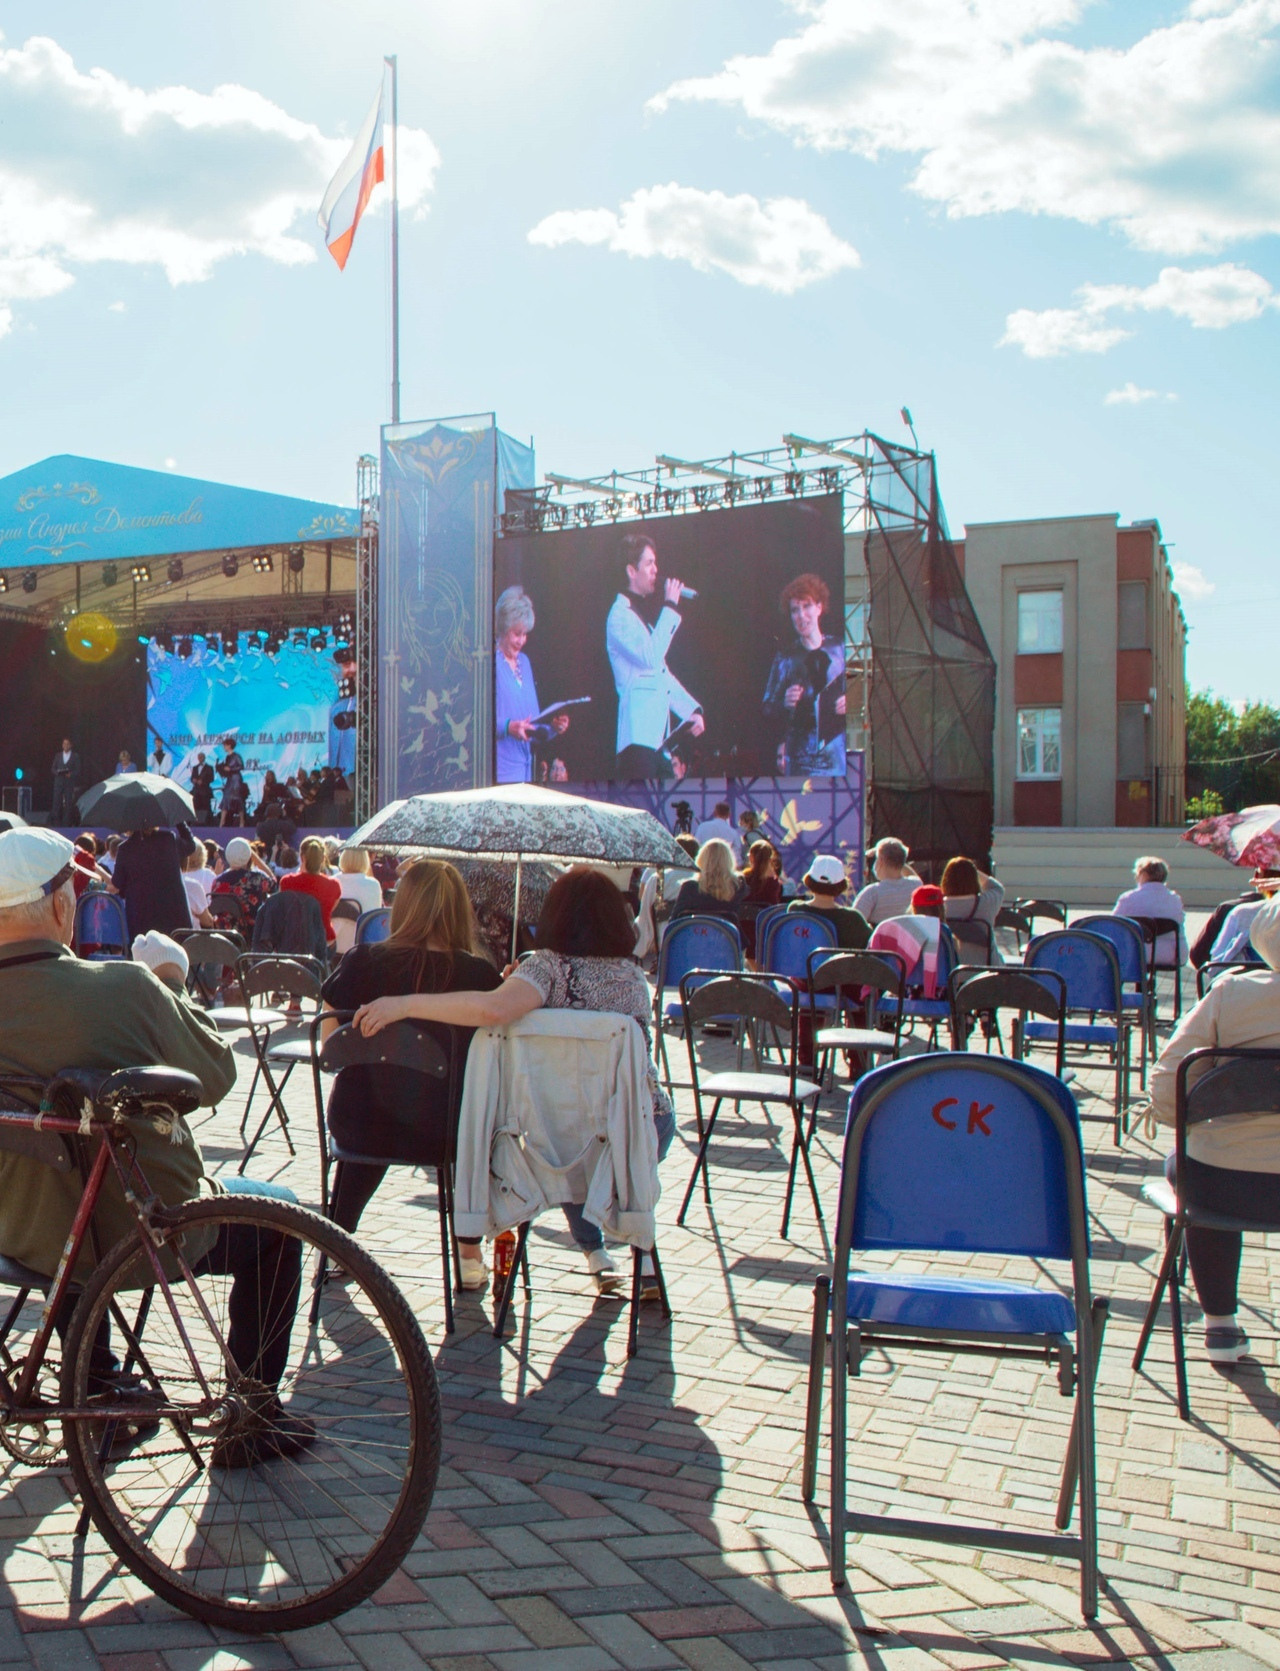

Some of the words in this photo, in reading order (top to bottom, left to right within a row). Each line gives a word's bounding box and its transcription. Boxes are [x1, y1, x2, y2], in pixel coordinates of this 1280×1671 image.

[27, 513, 88, 544] Андрея
[92, 497, 204, 533] Дементьева
[170, 734, 193, 746] МИР
[258, 731, 274, 744] НА
[276, 730, 326, 745] ДОБРЫХ
[932, 1097, 995, 1136] СК
